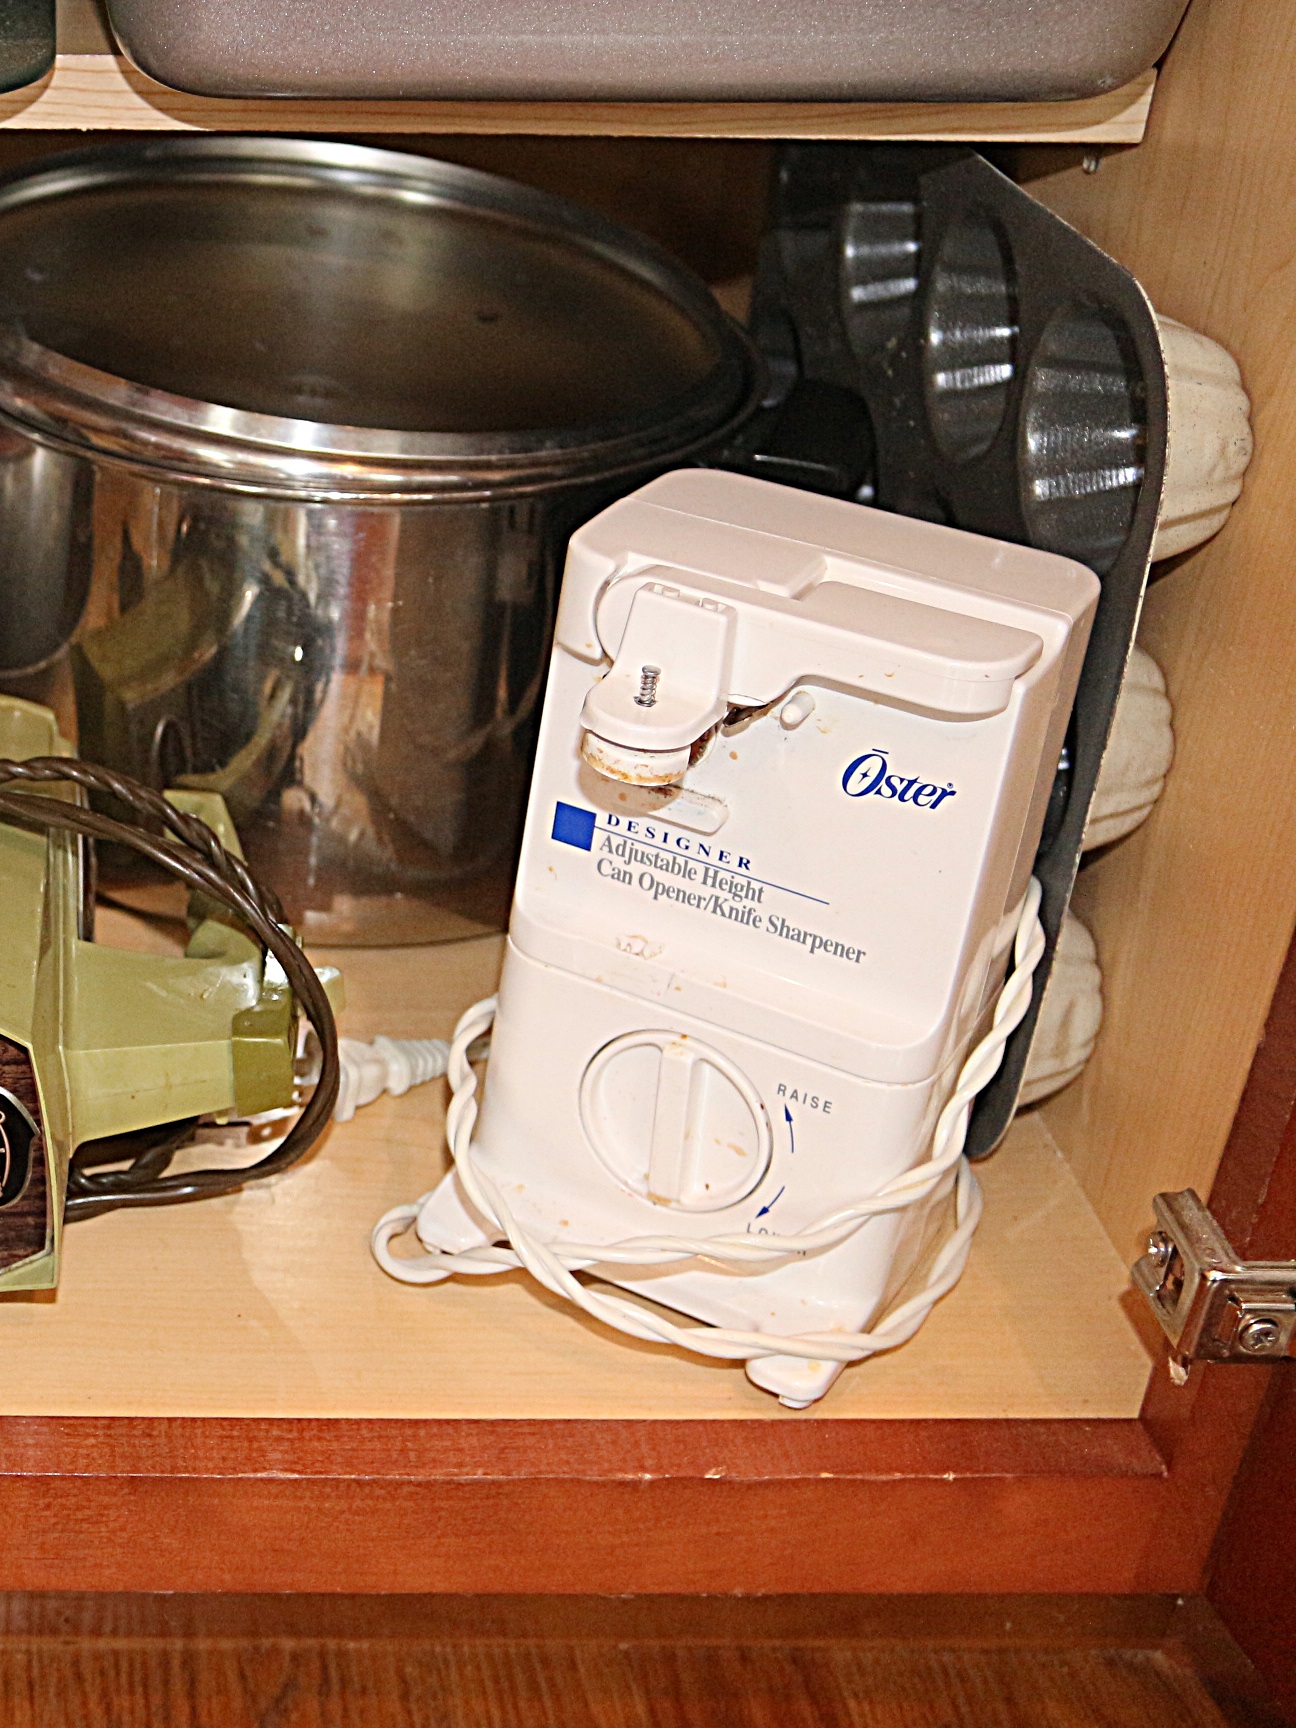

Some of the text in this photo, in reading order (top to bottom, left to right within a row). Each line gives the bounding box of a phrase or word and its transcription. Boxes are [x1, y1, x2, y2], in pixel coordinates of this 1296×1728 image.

[598, 834, 765, 904] Adjustable Height
[606, 813, 752, 871] DESIGNER
[596, 858, 867, 965] Can Opener/Knife Sharpener
[776, 1083, 833, 1114] RAISE
